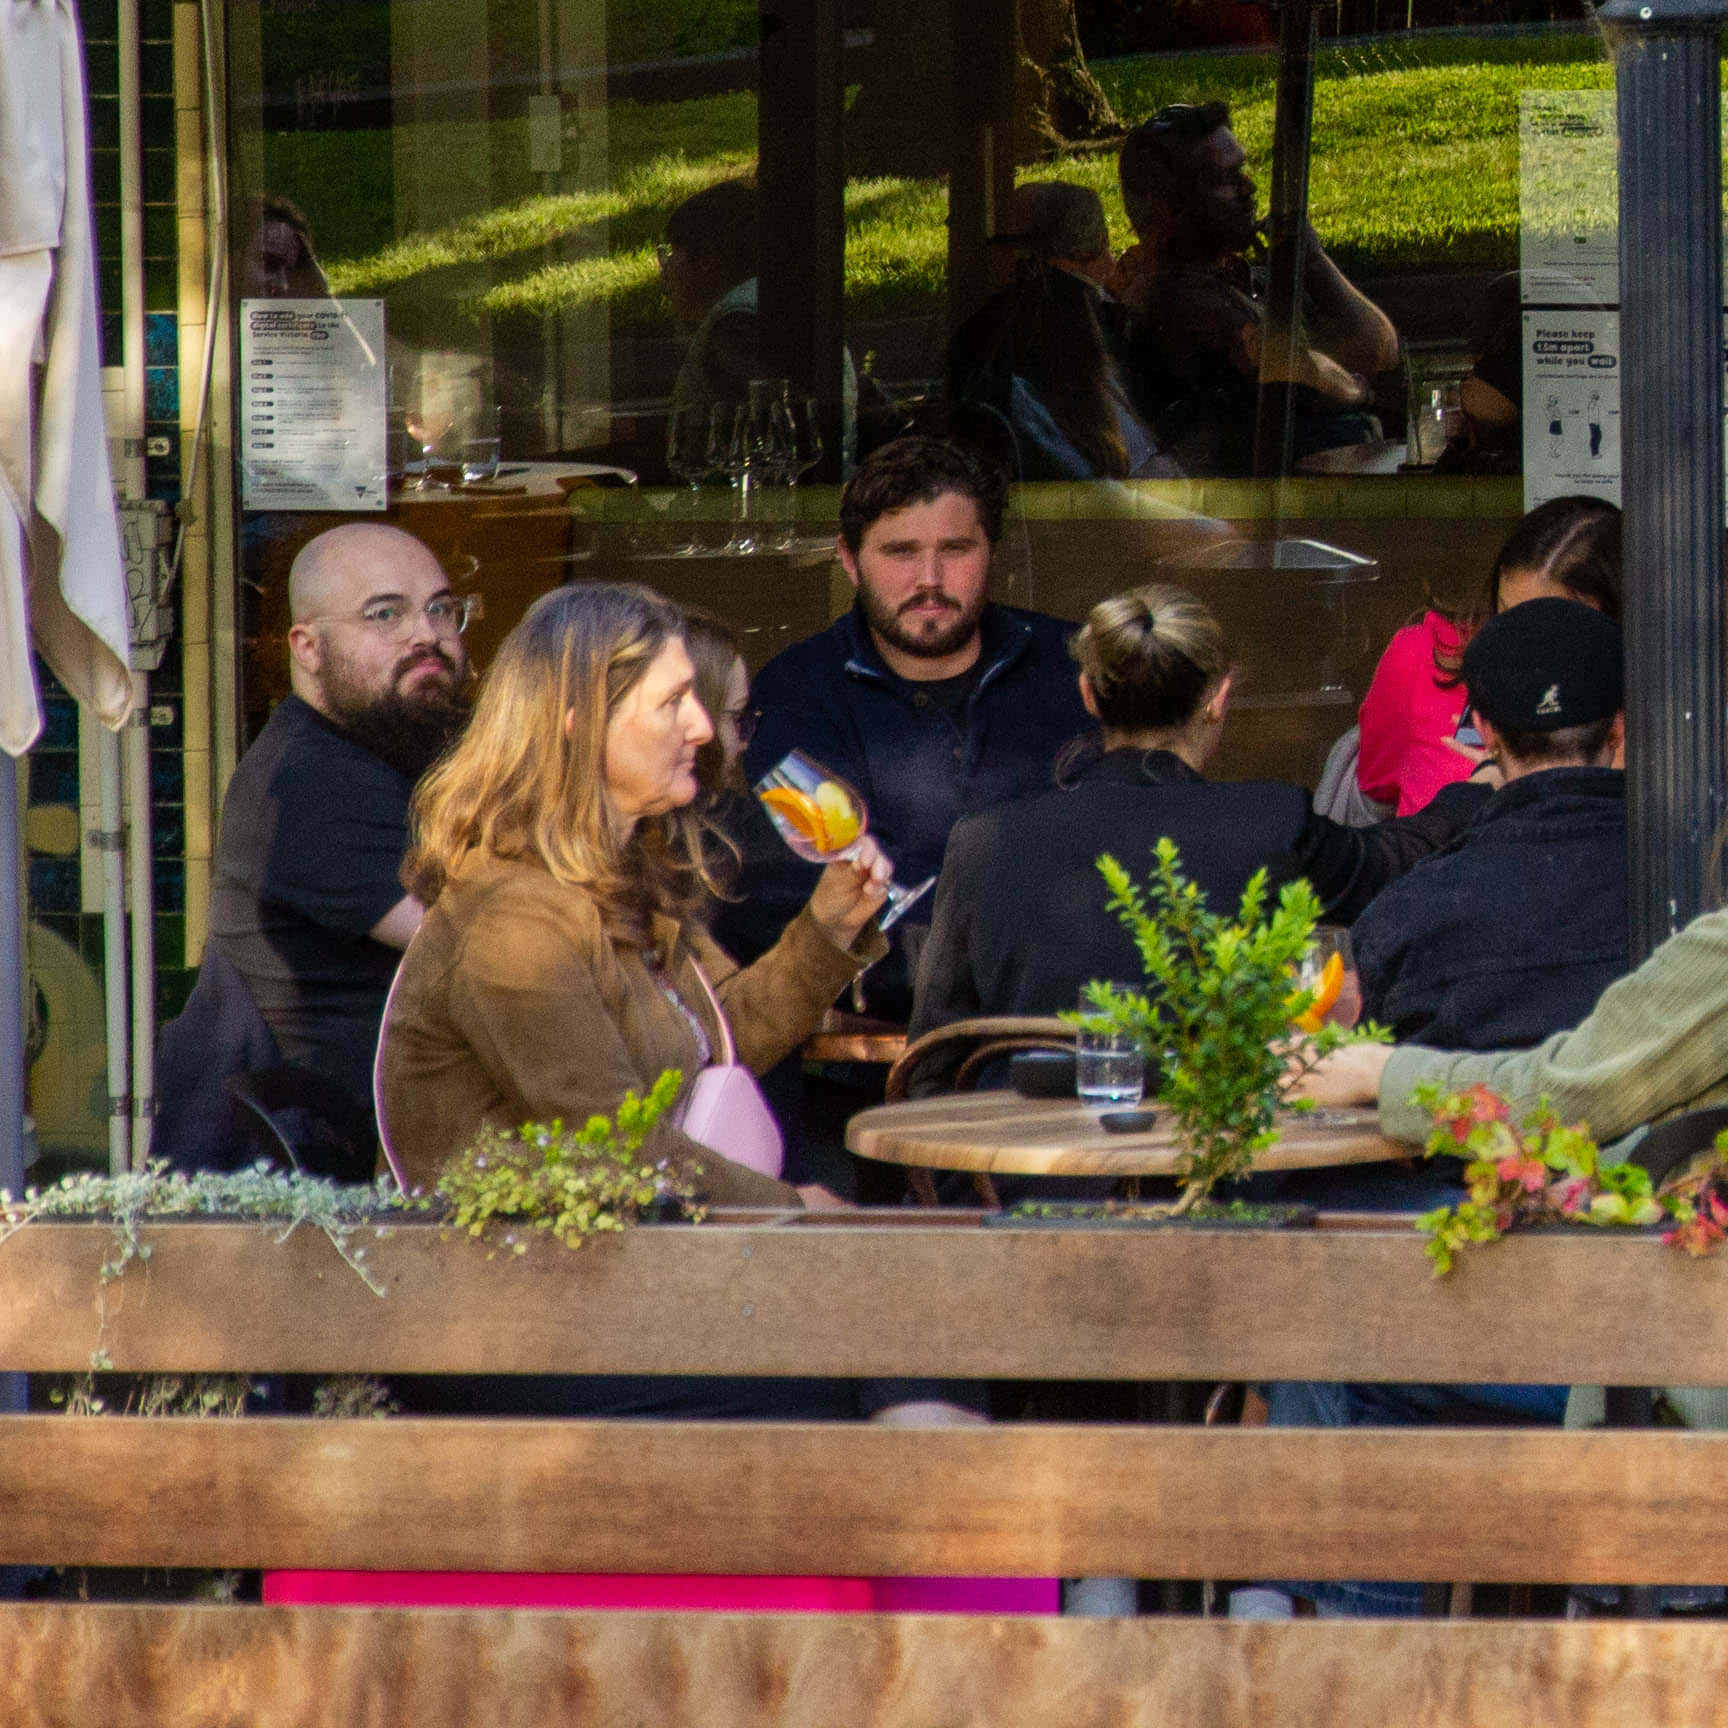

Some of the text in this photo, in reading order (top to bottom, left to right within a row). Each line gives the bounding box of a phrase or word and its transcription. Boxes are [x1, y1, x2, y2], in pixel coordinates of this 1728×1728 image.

[1536, 329, 1595, 339] Please keep
[1560, 343, 1590, 353] apart
[1536, 356, 1563, 365] while
[1566, 358, 1585, 367] you
